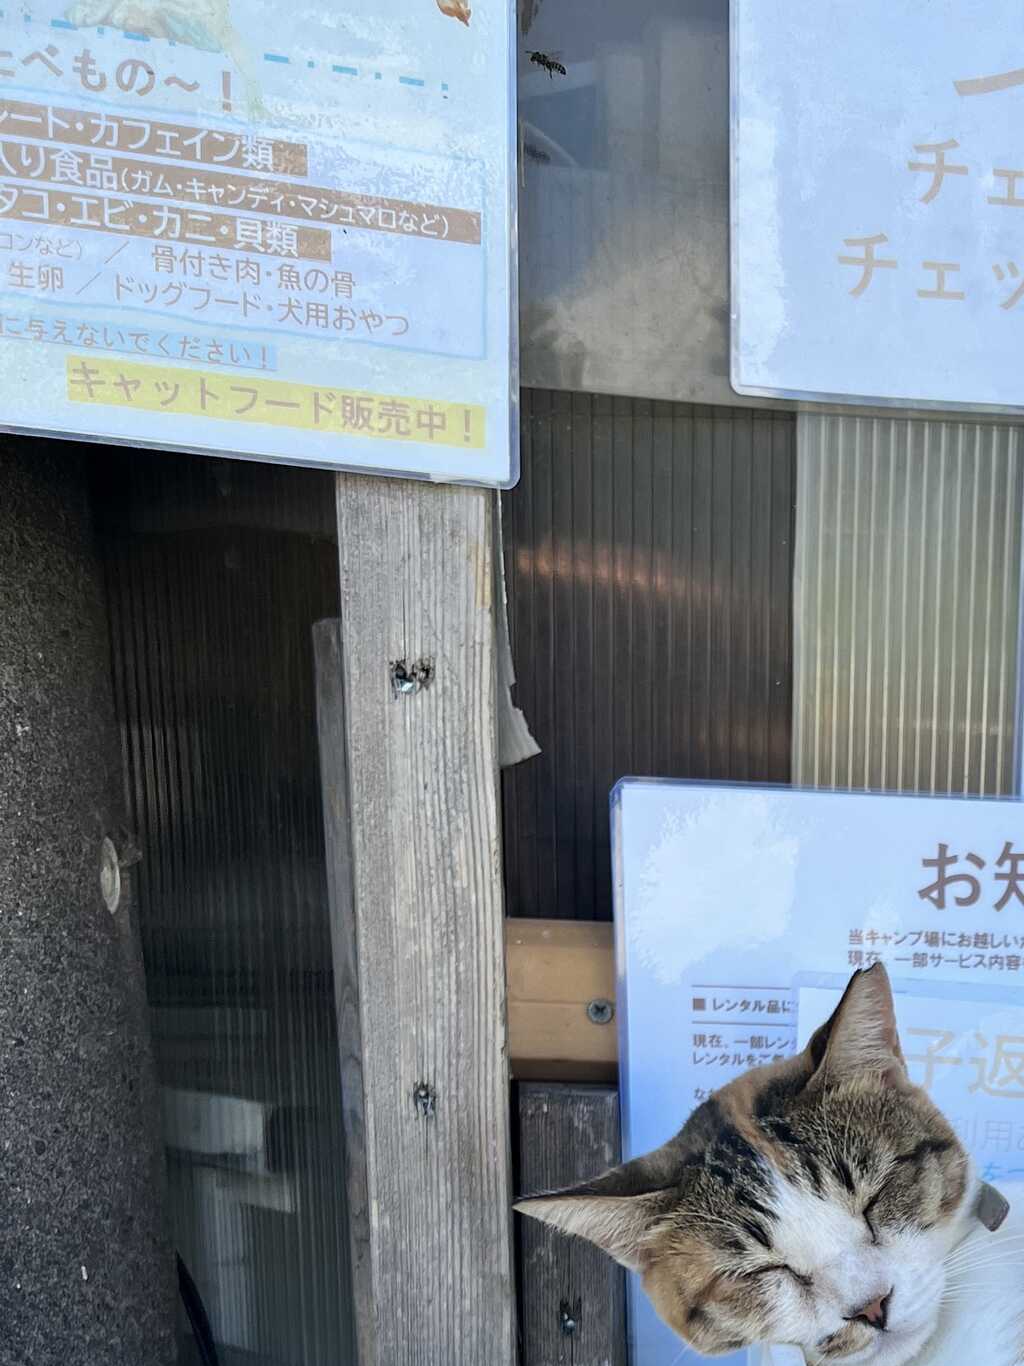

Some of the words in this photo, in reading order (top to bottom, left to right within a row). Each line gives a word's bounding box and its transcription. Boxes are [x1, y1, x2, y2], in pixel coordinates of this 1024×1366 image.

[0, 106, 274, 172] ート・カフェイン類
[8, 261, 65, 292] 生卵
[114, 273, 410, 336] ドッグフード・犬用おやつ
[152, 245, 356, 300] 骨付き肉・魚の骨
[69, 361, 473, 443] キャットフード販売中！
